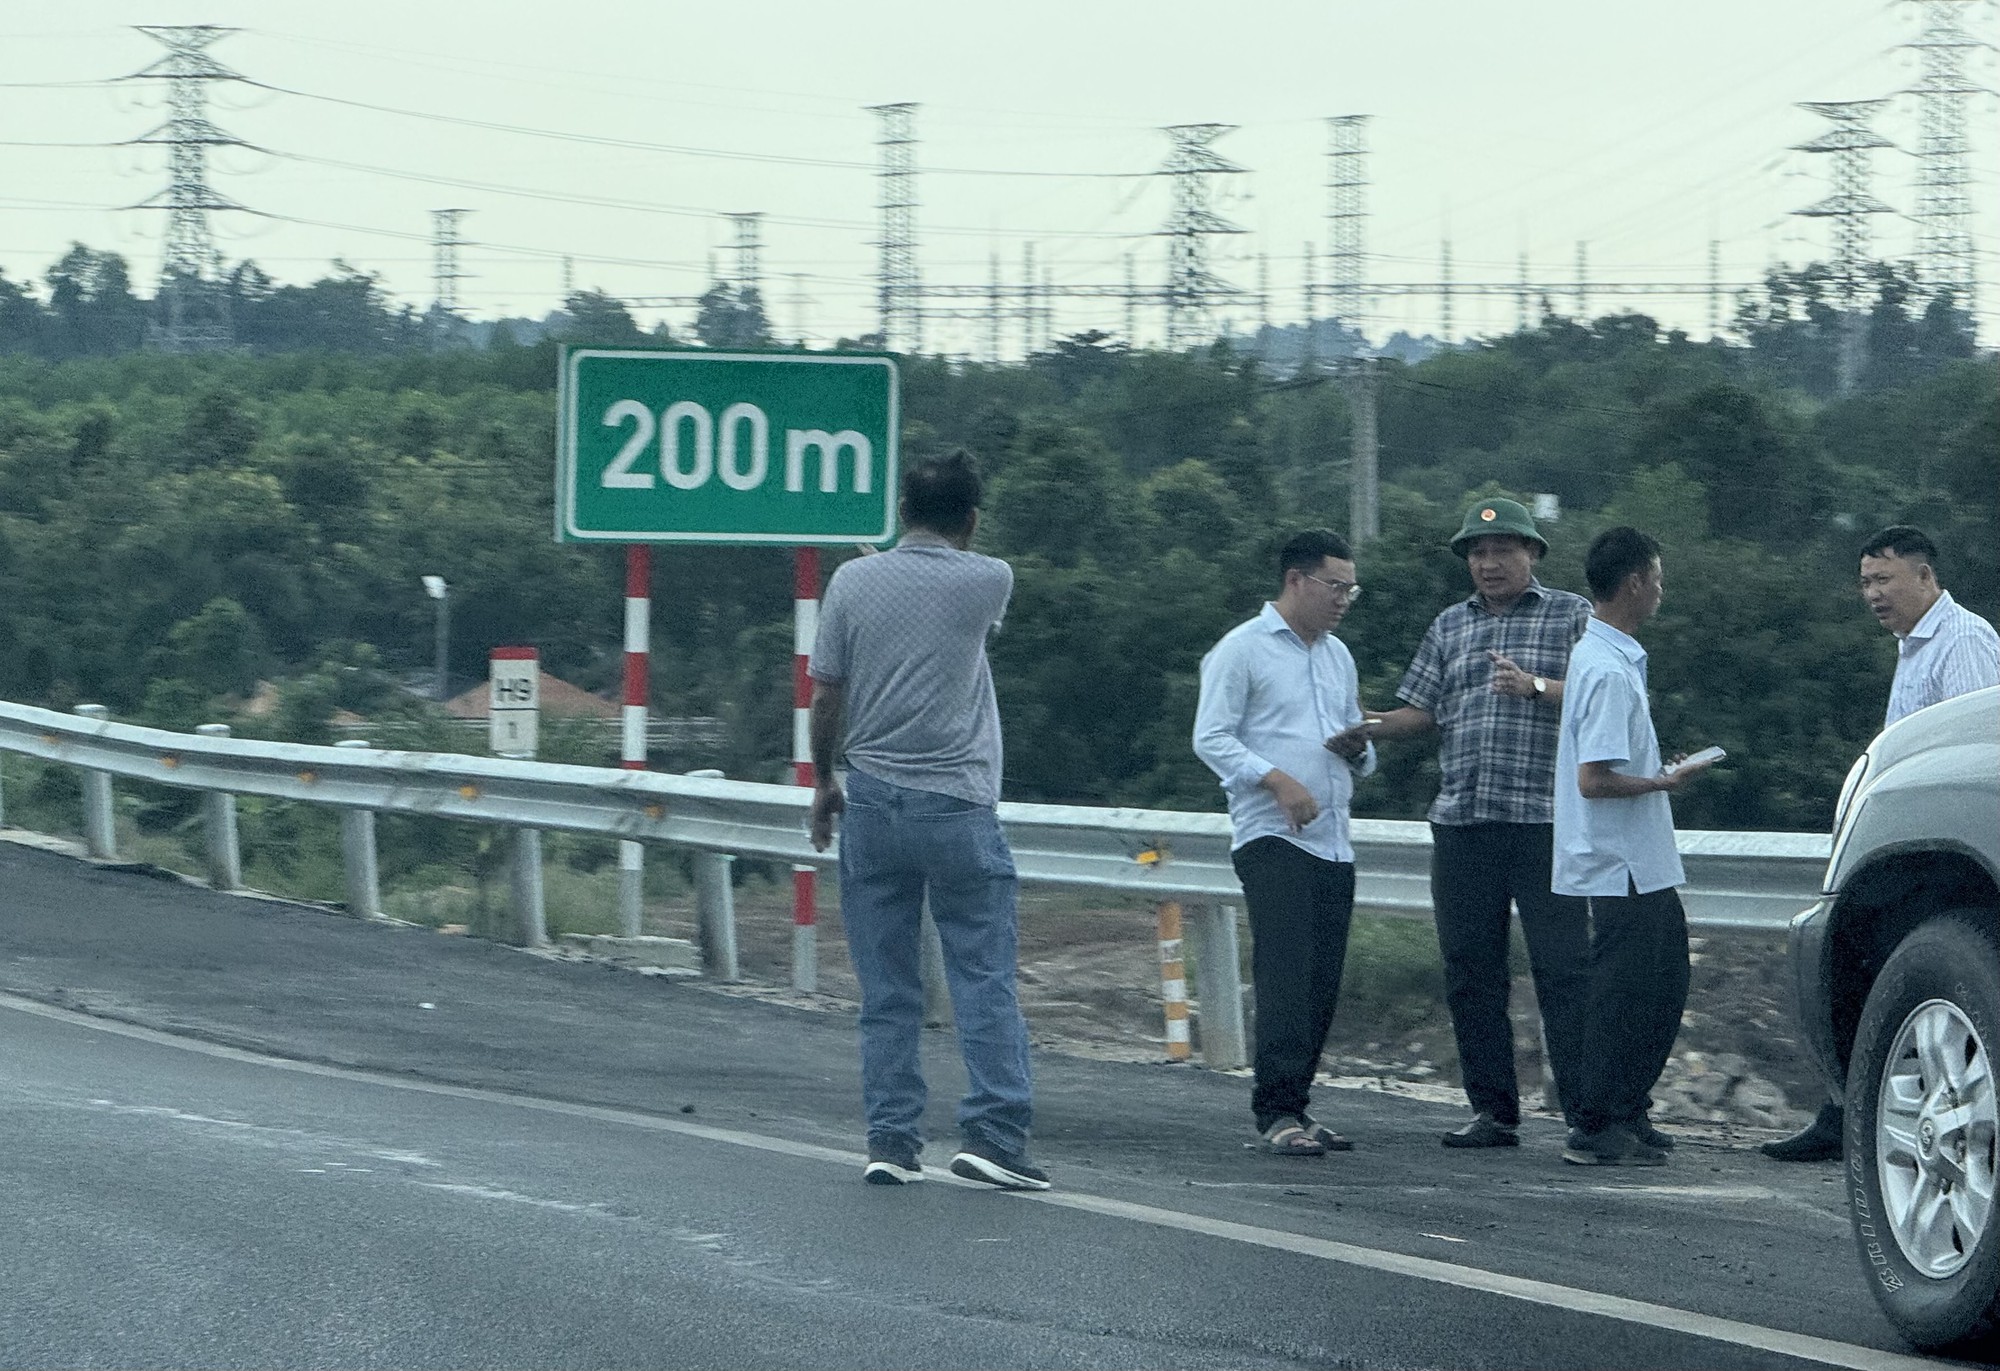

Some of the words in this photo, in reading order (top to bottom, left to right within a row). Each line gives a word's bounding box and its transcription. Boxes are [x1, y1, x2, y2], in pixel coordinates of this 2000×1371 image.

[601, 399, 769, 491] 200
[785, 428, 873, 494] m
[496, 678, 532, 702] H9
